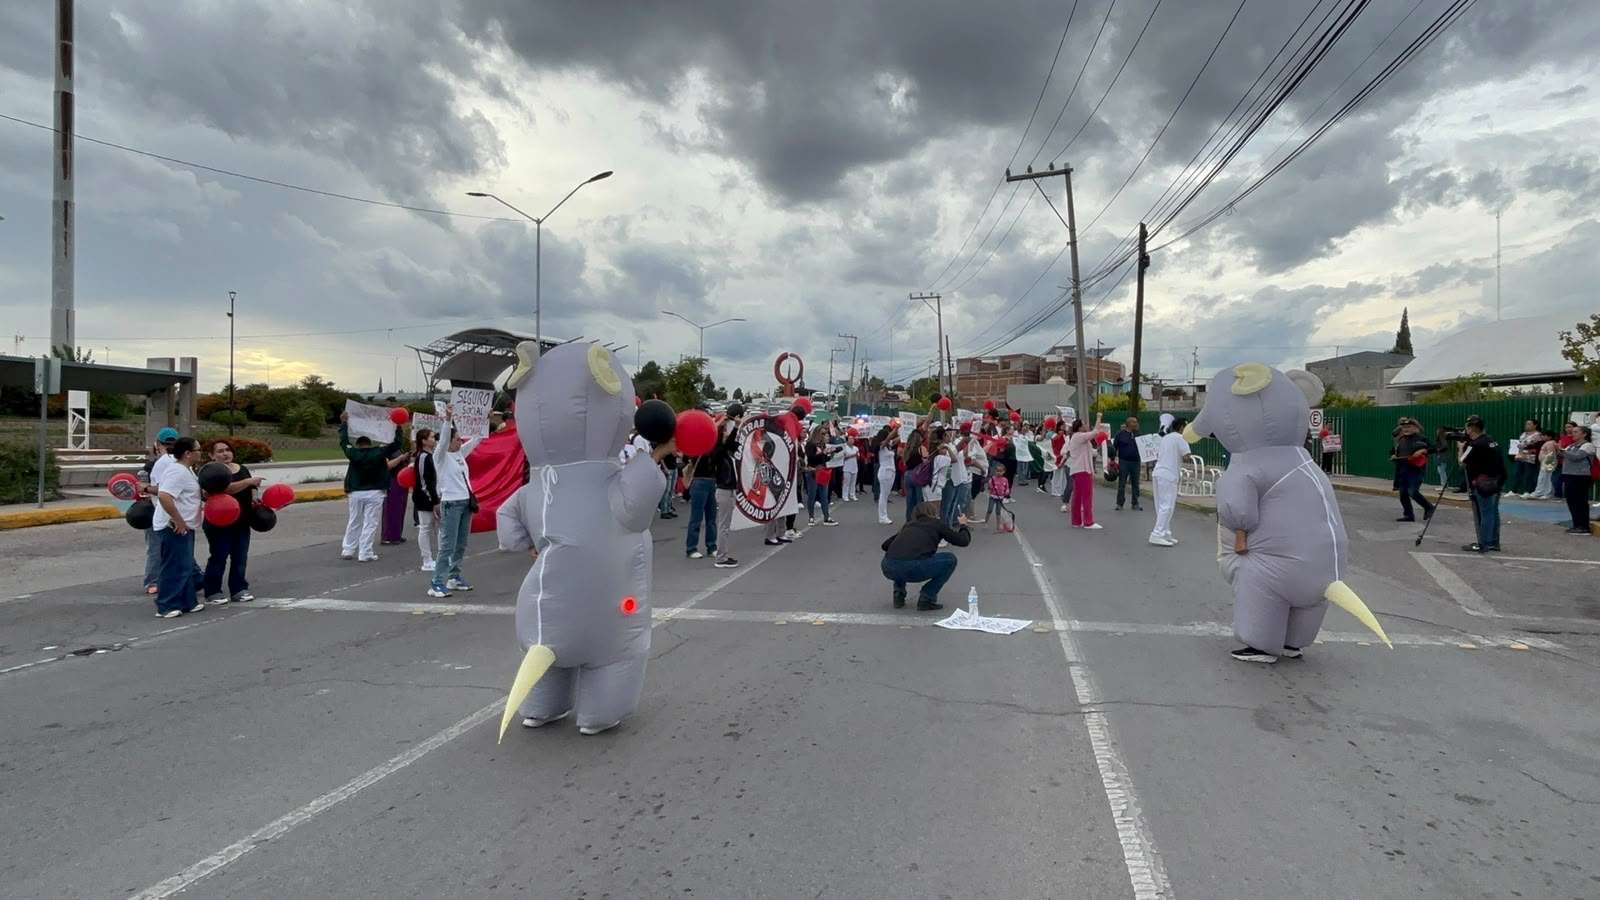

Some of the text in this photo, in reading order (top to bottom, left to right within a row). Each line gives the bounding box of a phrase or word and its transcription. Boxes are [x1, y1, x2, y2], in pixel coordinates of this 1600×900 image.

[457, 390, 490, 406] SEGURO
[463, 405, 483, 416] SOCIAL
[736, 491, 765, 520] UNIDAD
[765, 511, 770, 520] Y
